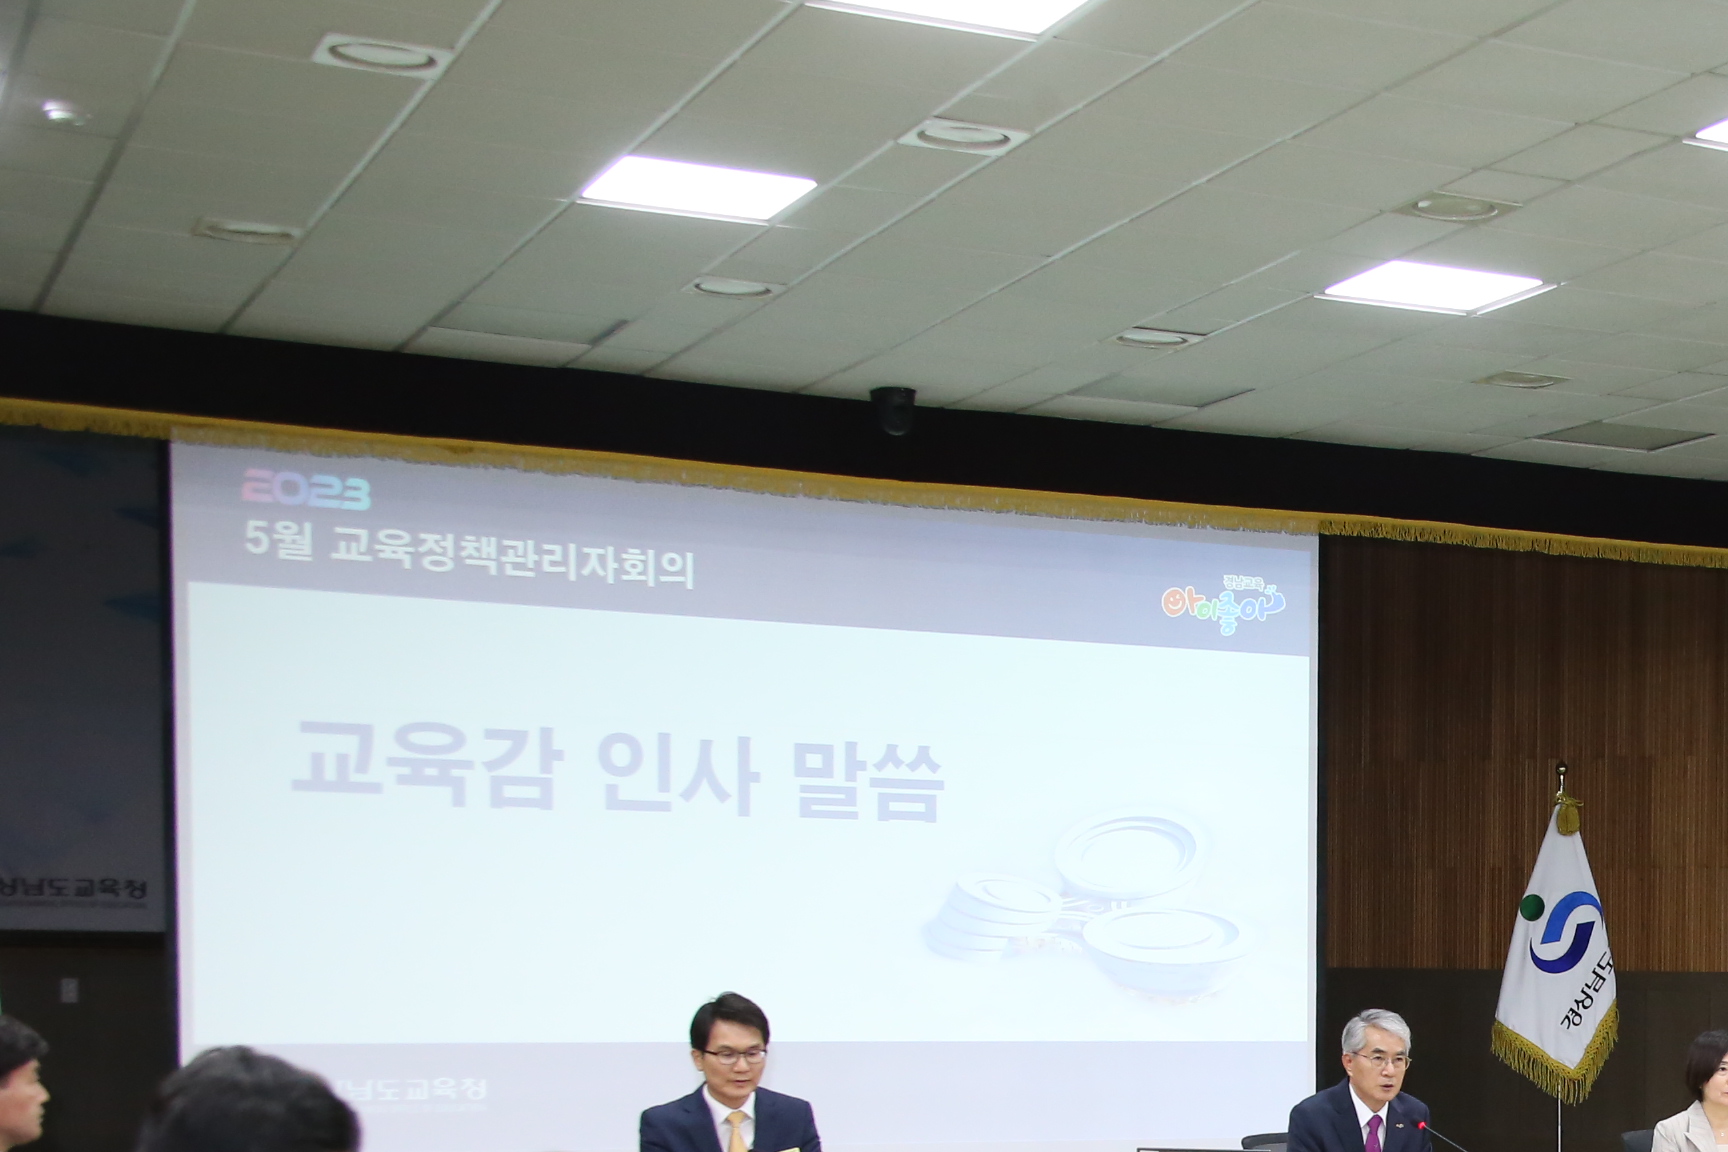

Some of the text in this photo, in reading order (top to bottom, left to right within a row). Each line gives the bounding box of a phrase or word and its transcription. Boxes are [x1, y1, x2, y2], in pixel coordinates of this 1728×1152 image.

[241, 469, 371, 511] 2023
[244, 519, 695, 590] 5월 교육정책관리자회의
[1223, 575, 1265, 592] 경남교육
[1162, 585, 1286, 636] 아이좋아
[291, 720, 945, 823] 교육감 인사 말씀
